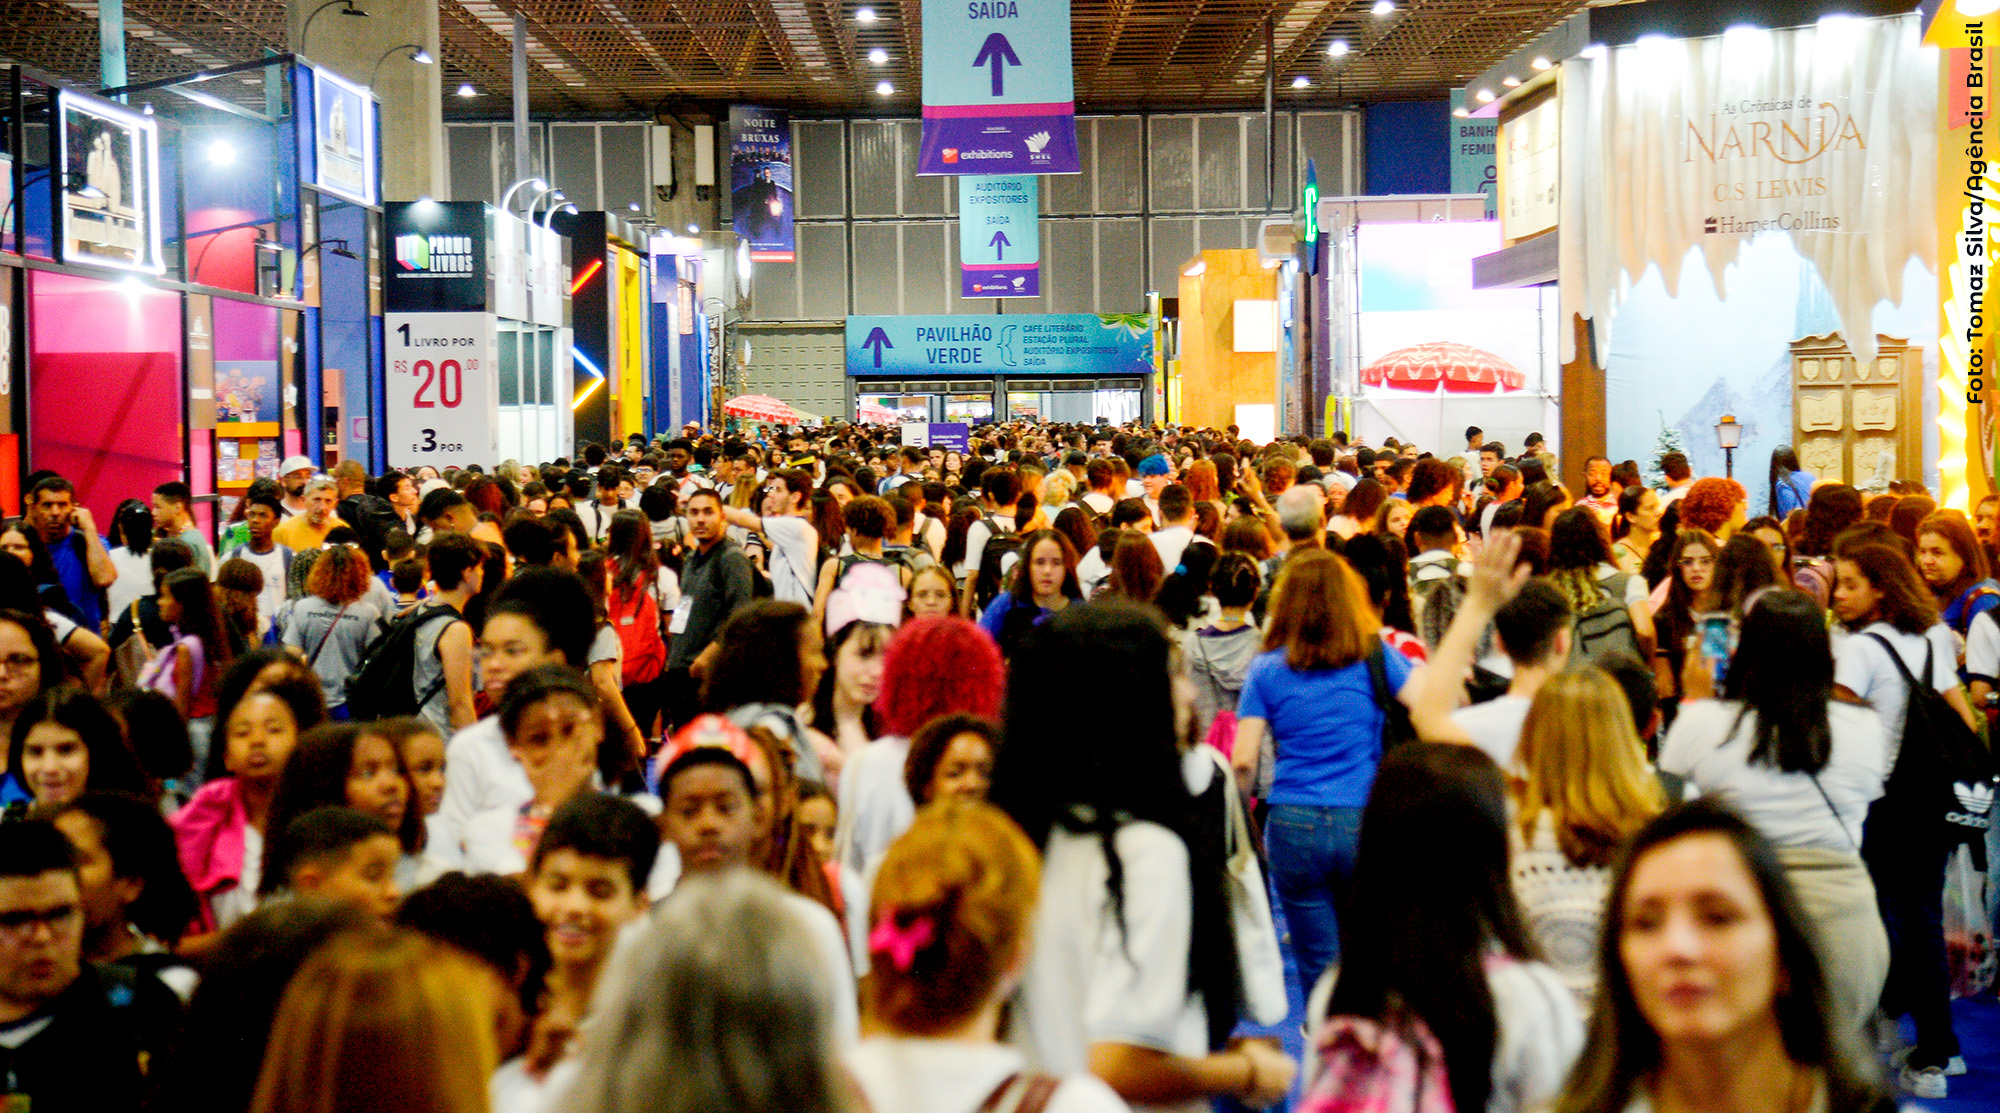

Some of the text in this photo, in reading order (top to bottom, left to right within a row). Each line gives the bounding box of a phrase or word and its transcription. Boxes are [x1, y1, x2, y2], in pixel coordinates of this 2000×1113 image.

[968, 0, 1019, 19] SAÍDA
[1721, 94, 1812, 115] As Crônicas de
[744, 119, 776, 128] NOITE
[741, 134, 780, 143] BRUXAS
[961, 150, 1013, 160] exhibitions
[975, 182, 1023, 192] AUDITÓRIO
[1757, 177, 1827, 199] LEWIS
[970, 195, 1028, 204] EXPOSITORES
[1720, 211, 1840, 238] HarperCollins
[429, 237, 472, 254] PROMO
[430, 255, 473, 272] LIVROS
[397, 323, 475, 347] 1 LIVRO POR
[916, 324, 992, 341] PAVILHÃO
[1044, 322, 1084, 332] LITERÁRIO
[1023, 335, 1088, 343] ESTAÇÃO PLURAL
[926, 347, 982, 364] VERDE
[1066, 346, 1118, 354] EXPOSITORES
[412, 359, 462, 409] 20
[412, 428, 463, 452] E 3 POR
